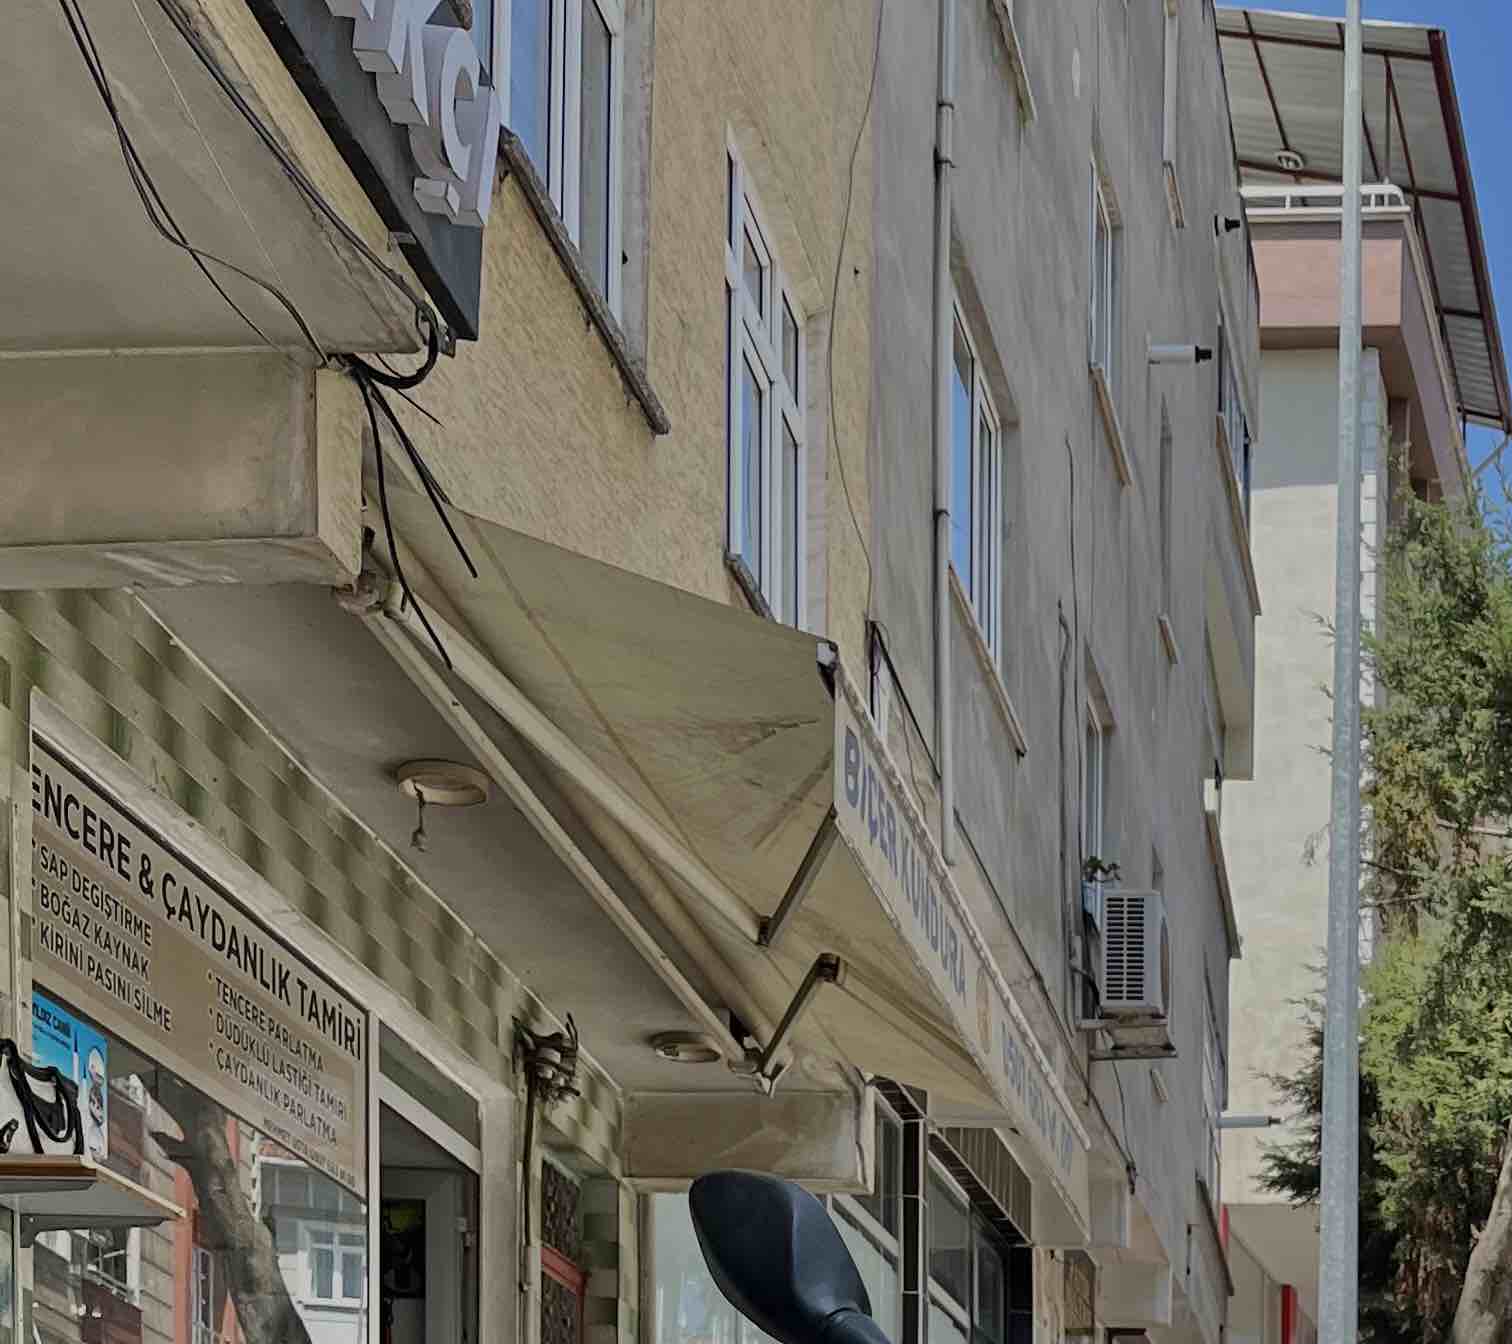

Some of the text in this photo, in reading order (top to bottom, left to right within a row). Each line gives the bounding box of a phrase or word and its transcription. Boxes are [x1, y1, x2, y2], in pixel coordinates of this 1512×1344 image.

[40, 846, 68, 881] SAP
[40, 883, 150, 980] BOĞAZ KAYNAK
[138, 853, 155, 899] &
[161, 872, 291, 1007] ÇAYDANLIK
[296, 977, 362, 1061] TAMİRİ
[87, 955, 131, 1004] PASINI
[134, 987, 172, 1032] SİLME
[215, 976, 324, 1073] TENCERE PARLATMA
[215, 1047, 337, 1144] ÇAYDANLIK PARLATMA
